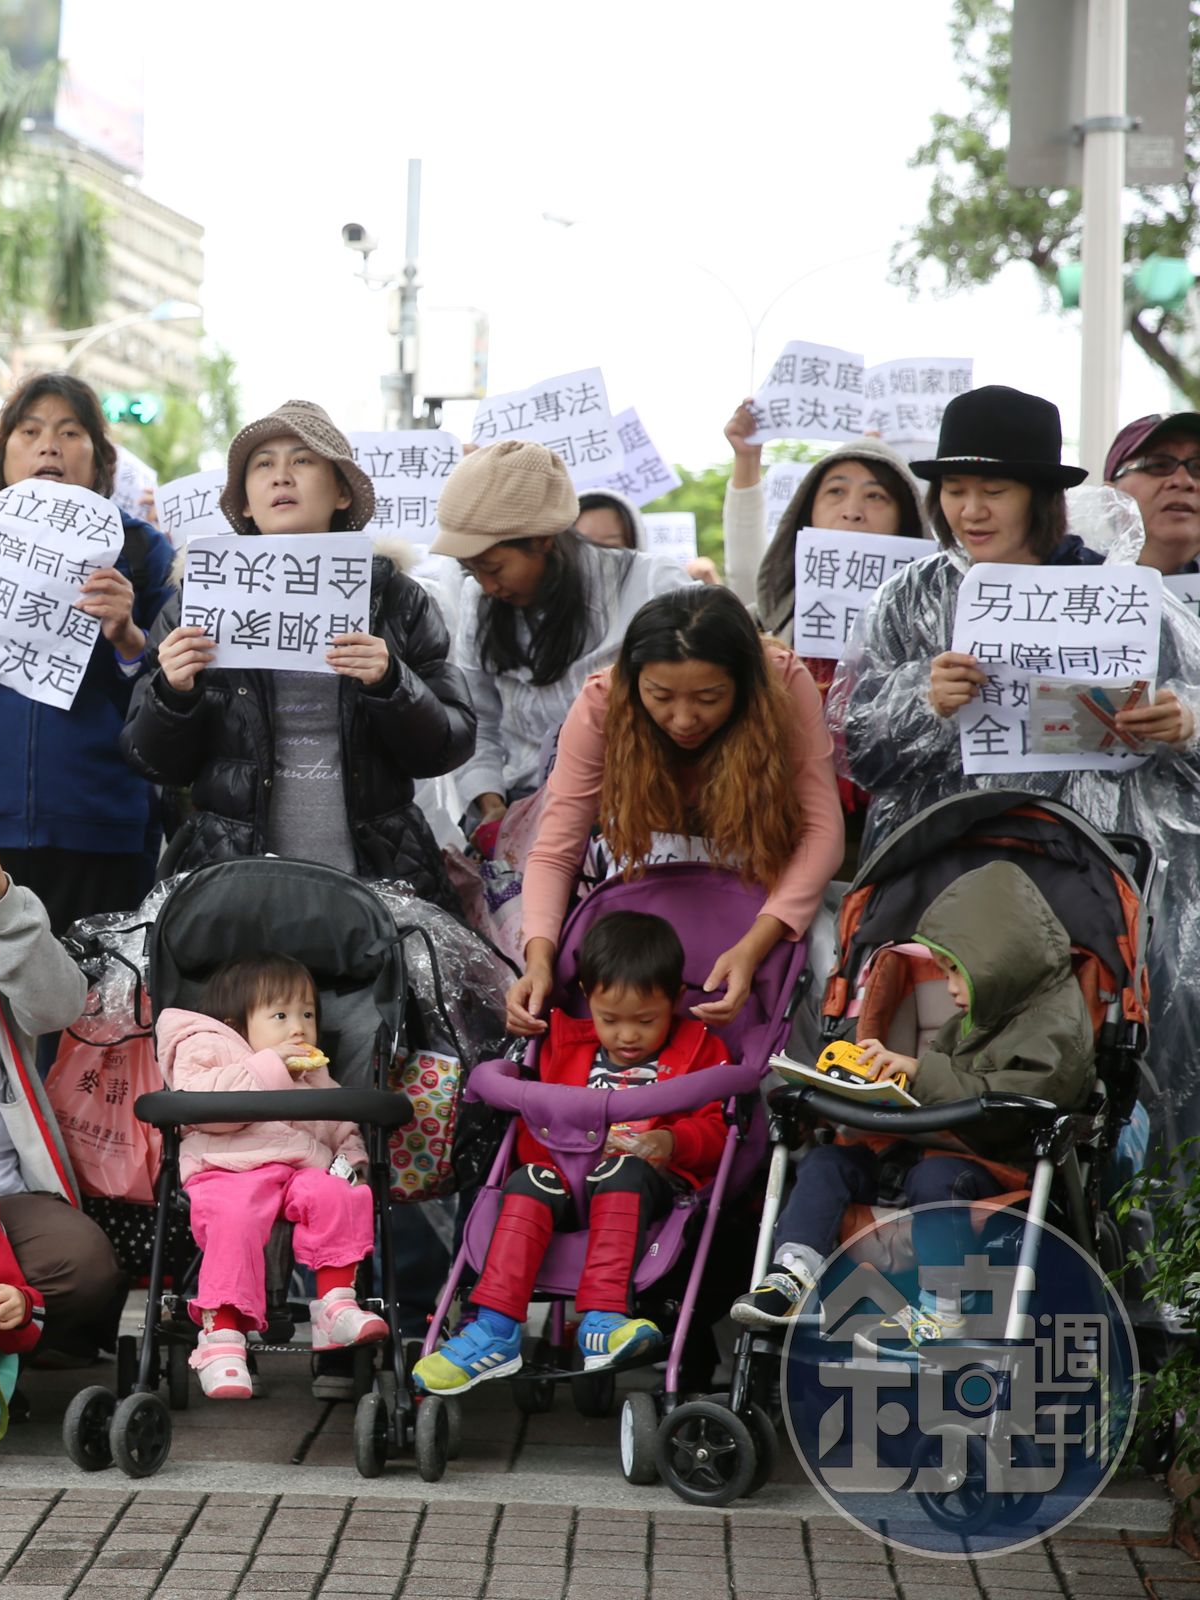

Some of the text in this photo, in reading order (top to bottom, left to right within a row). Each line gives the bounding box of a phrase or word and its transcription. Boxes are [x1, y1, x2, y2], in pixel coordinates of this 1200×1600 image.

[474, 382, 603, 441] 另立專法
[163, 485, 225, 535] 另立
[187, 549, 368, 600] 全民決定
[967, 581, 1150, 626] 另立專法
